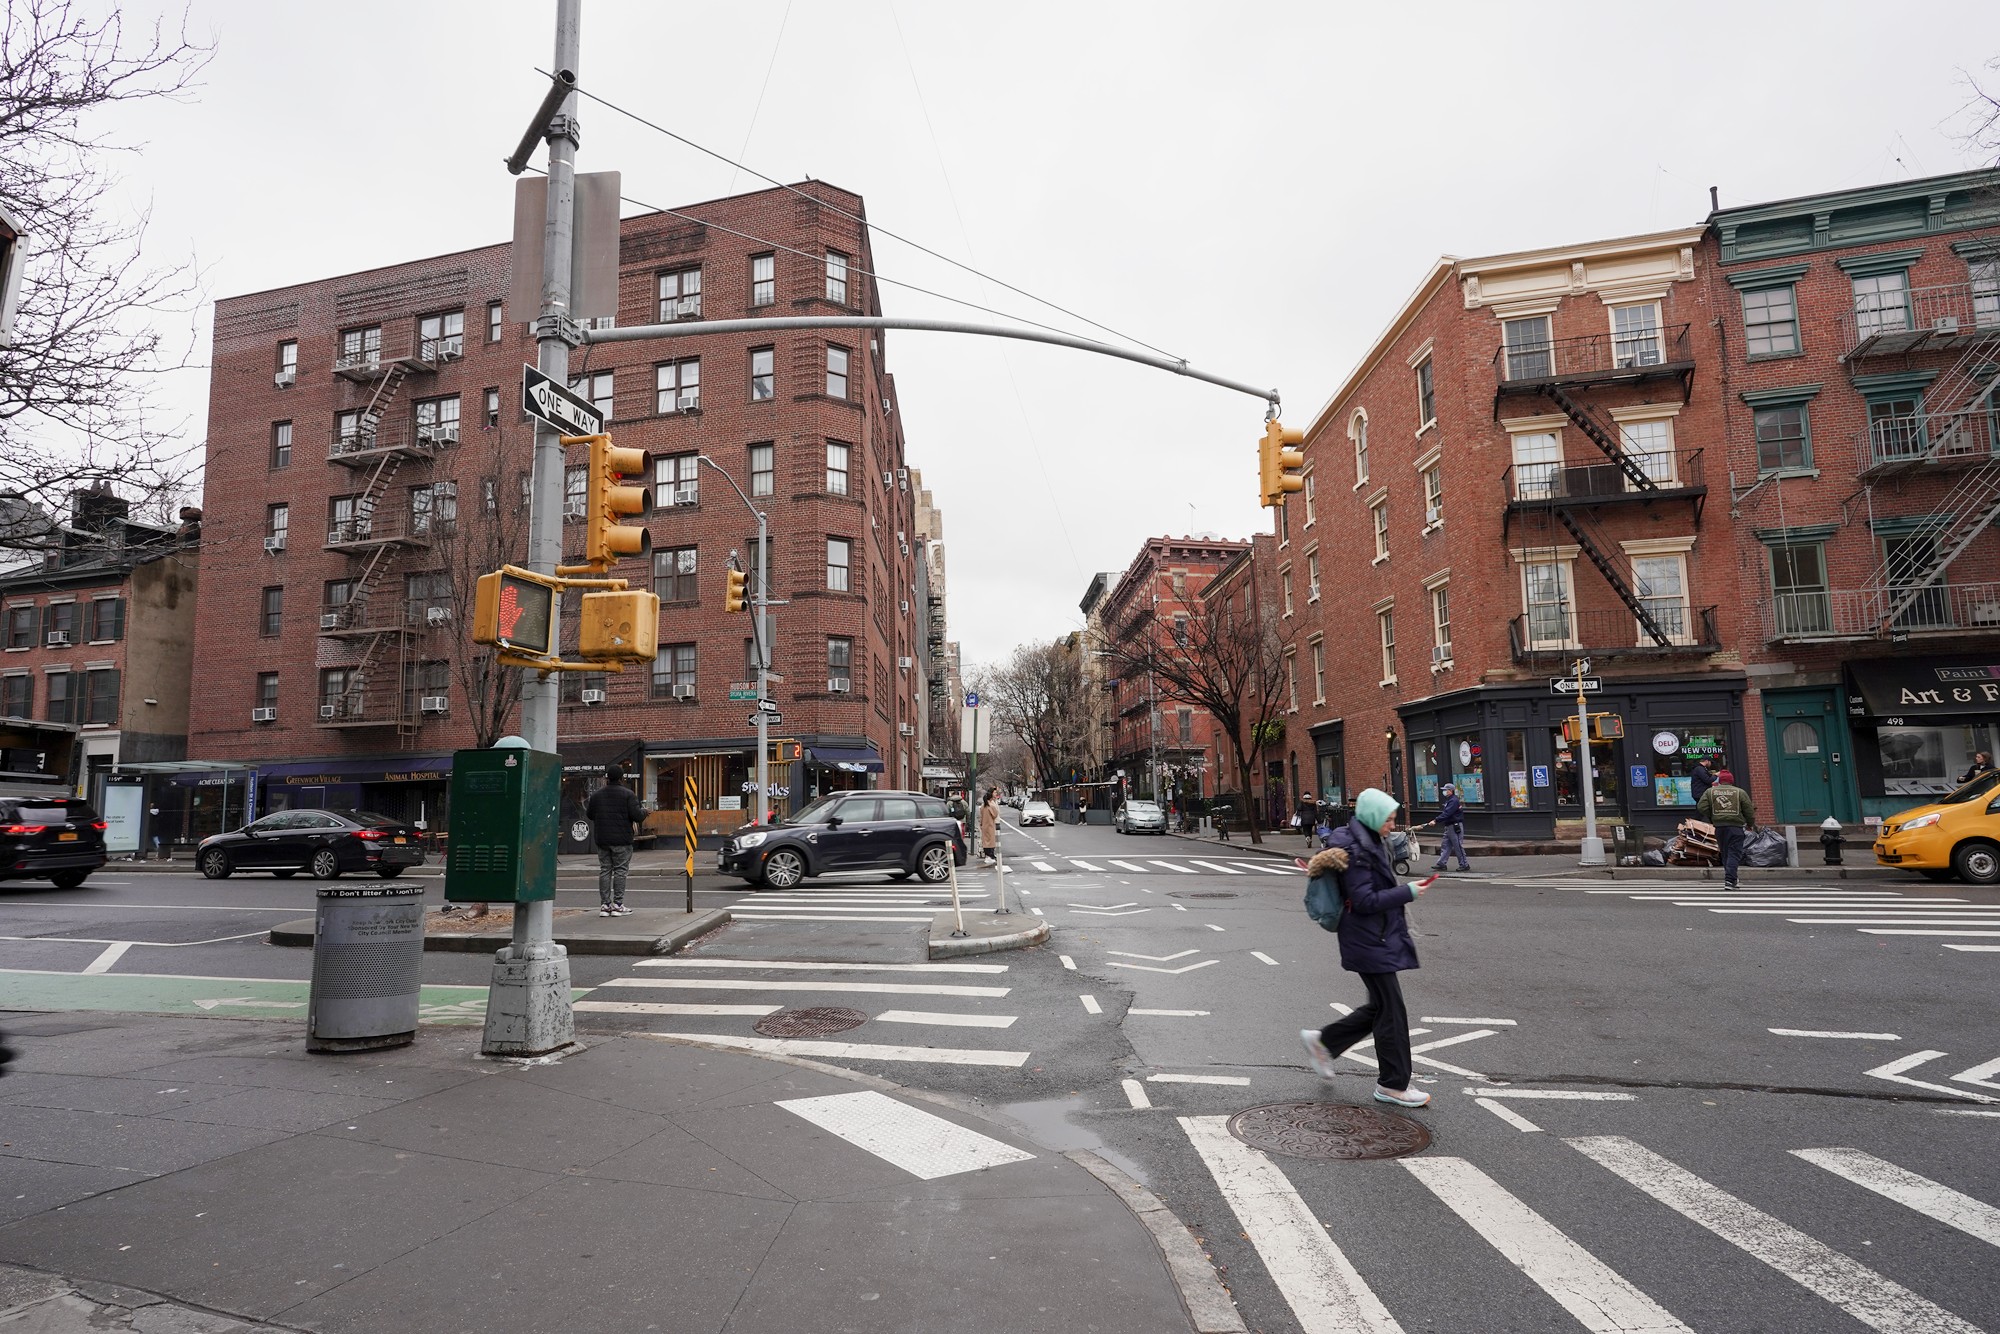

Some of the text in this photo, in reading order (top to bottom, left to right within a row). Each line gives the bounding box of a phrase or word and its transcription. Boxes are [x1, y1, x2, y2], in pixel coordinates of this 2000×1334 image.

[539, 387, 595, 433] ONE WAY
[1940, 669, 1988, 679] Paint
[730, 682, 750, 690] HUDSON
[1560, 682, 1575, 690] ONE
[1900, 687, 1945, 704] Art
[1953, 688, 1972, 702] &
[1886, 717, 1904, 726] 498
[794, 745, 800, 757] 2
[286, 774, 342, 784] GREENWICH VILLAGE
[384, 770, 440, 781] ANIMAL HOSPITAL
